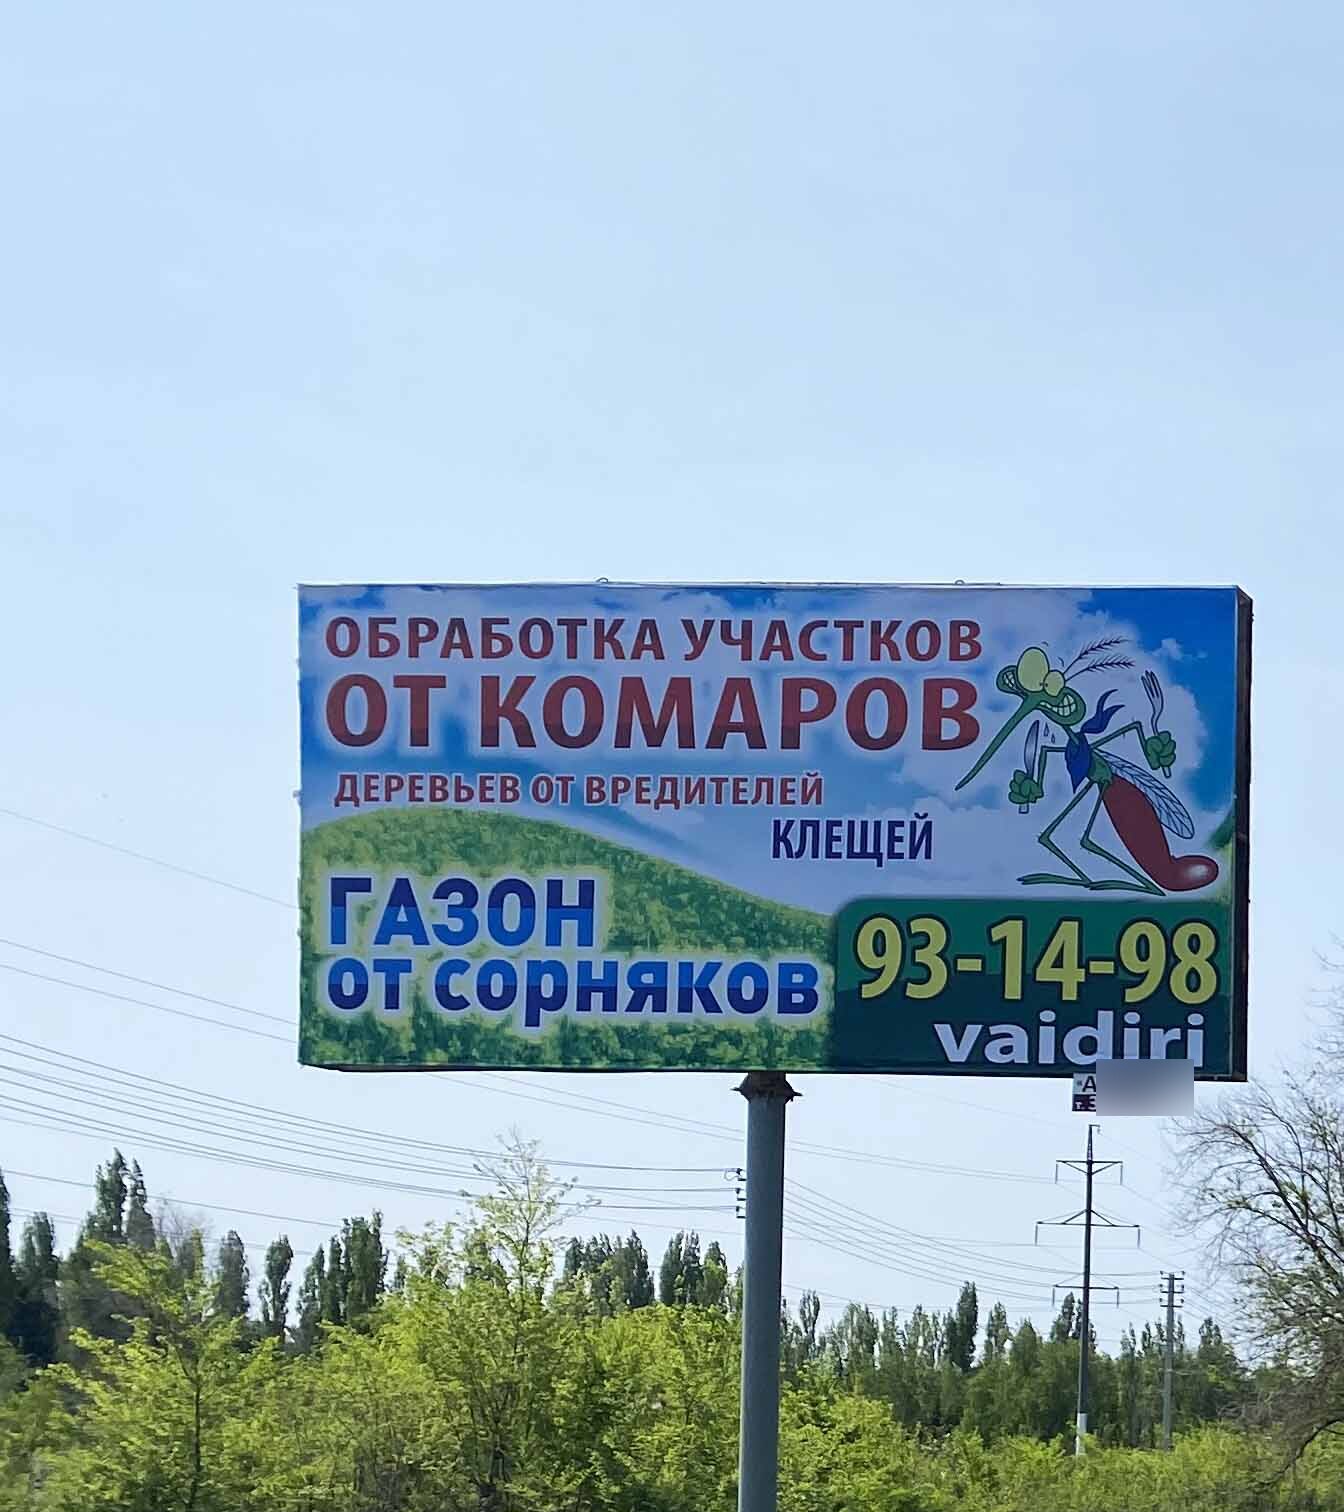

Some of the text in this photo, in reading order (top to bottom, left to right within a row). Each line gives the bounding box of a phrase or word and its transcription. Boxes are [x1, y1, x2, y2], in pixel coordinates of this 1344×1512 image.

[325, 616, 983, 662] ОБРАБОТКА УЧАСТКОВ
[325, 673, 981, 750] ОТ КОМАРОВ
[334, 772, 823, 810] ДЕРЕВЬЕВ ОТ ВРЕДИТЕЛЕЙ
[772, 812, 934, 868] КЛЕЩЕЙ
[329, 876, 595, 947] ГАЗОН
[856, 917, 1217, 1005] 93-14-98
[434, 958, 820, 1028] сорняков
[934, 1010, 1204, 1067] vaidiri
